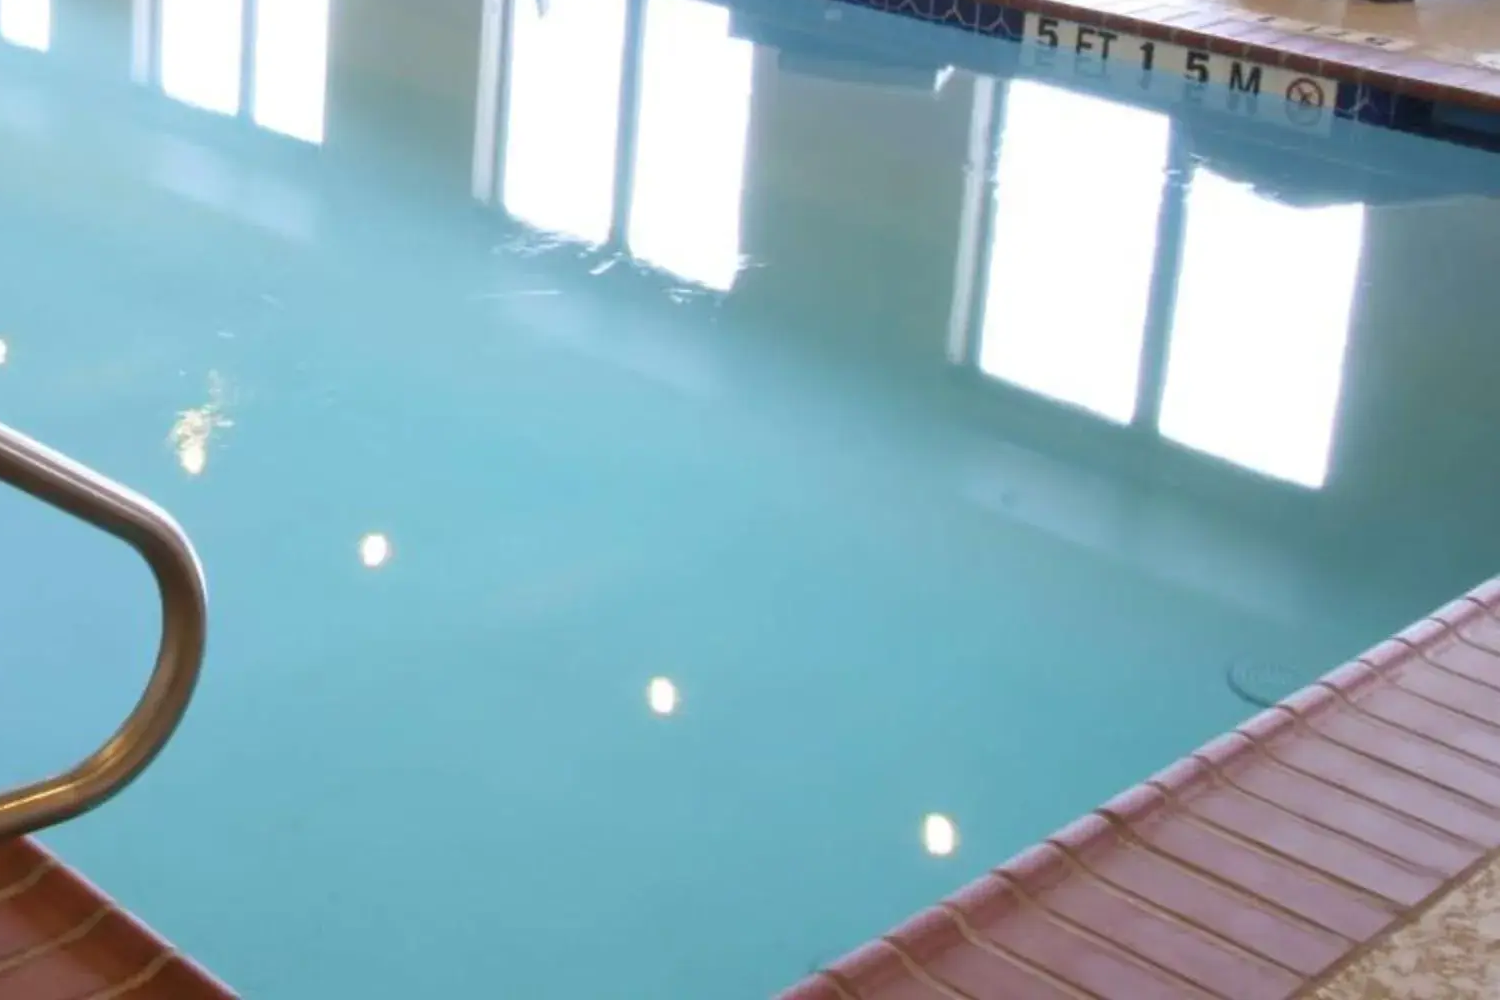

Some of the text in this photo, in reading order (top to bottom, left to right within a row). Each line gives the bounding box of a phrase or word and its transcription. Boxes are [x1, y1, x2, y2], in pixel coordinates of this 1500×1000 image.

[1037, 18, 1058, 48] 5
[1075, 27, 1118, 60] FT
[1230, 61, 1262, 97] M
